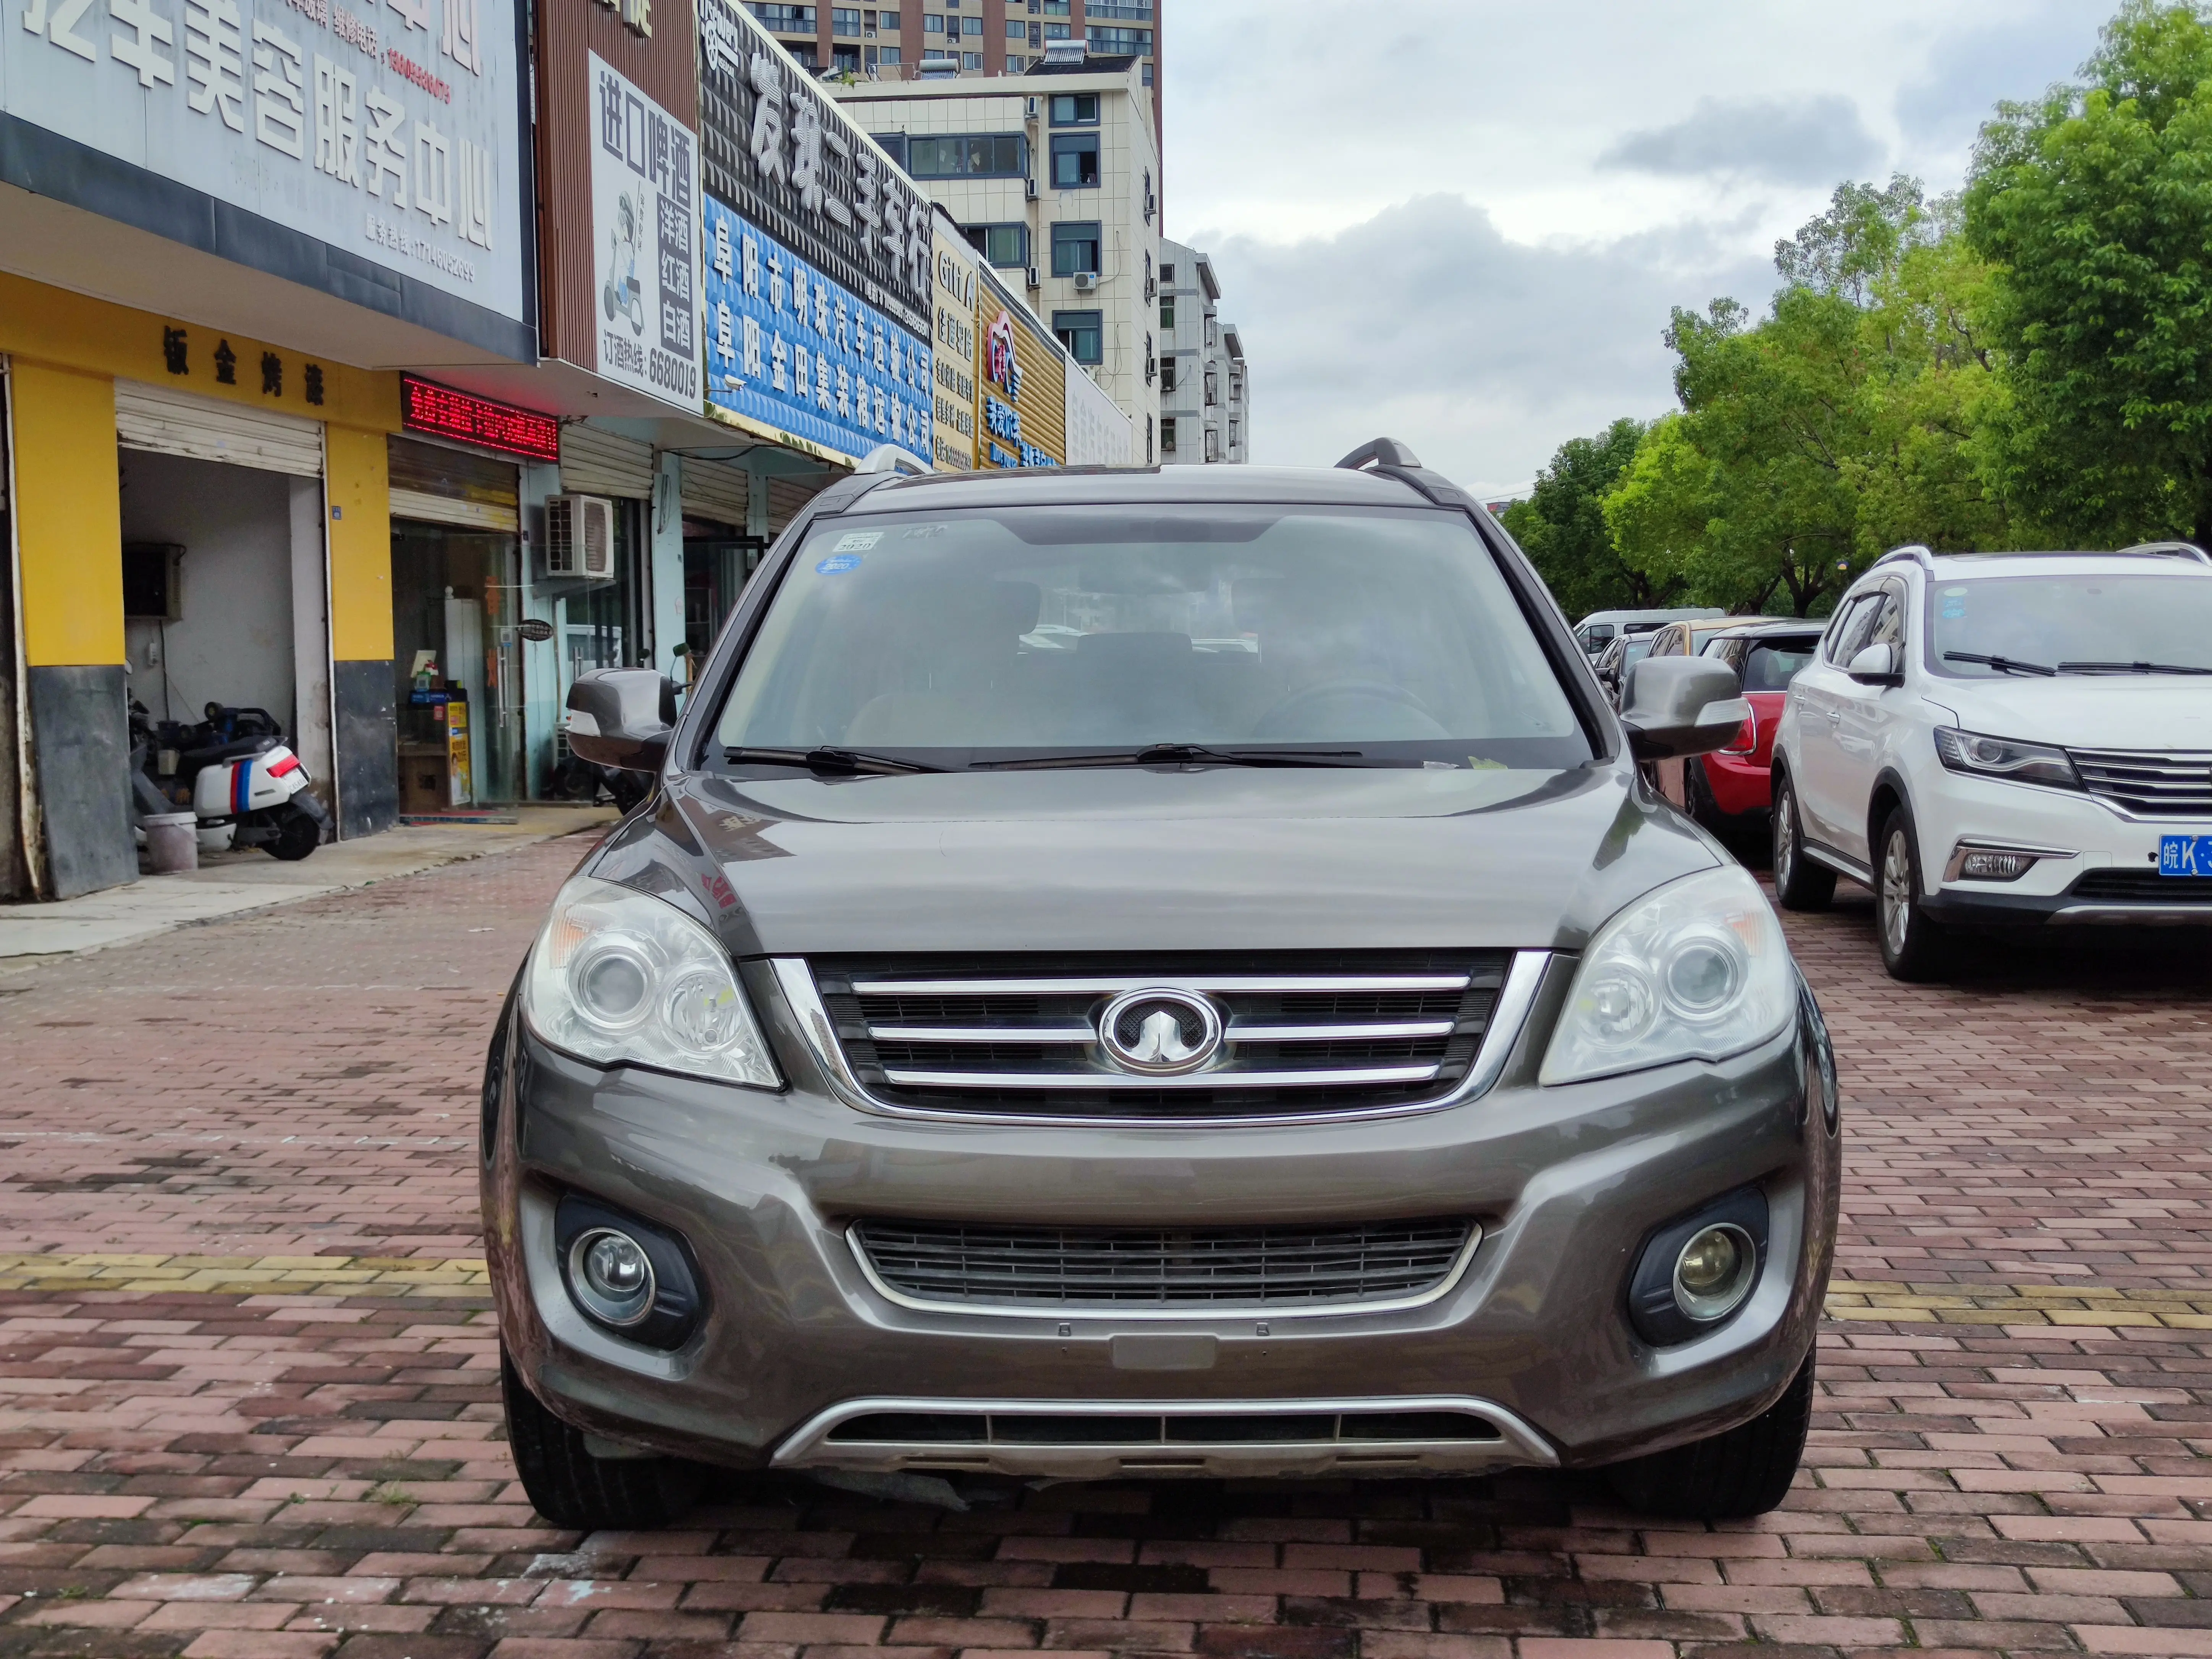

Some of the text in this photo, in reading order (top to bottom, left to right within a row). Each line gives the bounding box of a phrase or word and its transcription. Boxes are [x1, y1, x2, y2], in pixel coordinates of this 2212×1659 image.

[598, 70, 690, 210] 进口啤酒
[751, 52, 928, 306] 发现二手车行
[660, 199, 689, 255] 洋酒
[661, 249, 690, 302] 红酒
[663, 299, 691, 351] 白酒
[714, 216, 929, 393] 阜阳市明珠汽车运输公司
[716, 301, 929, 451] 阜阳金田集装箱运输公司
[2163, 841, 2212, 869] 皖K·
